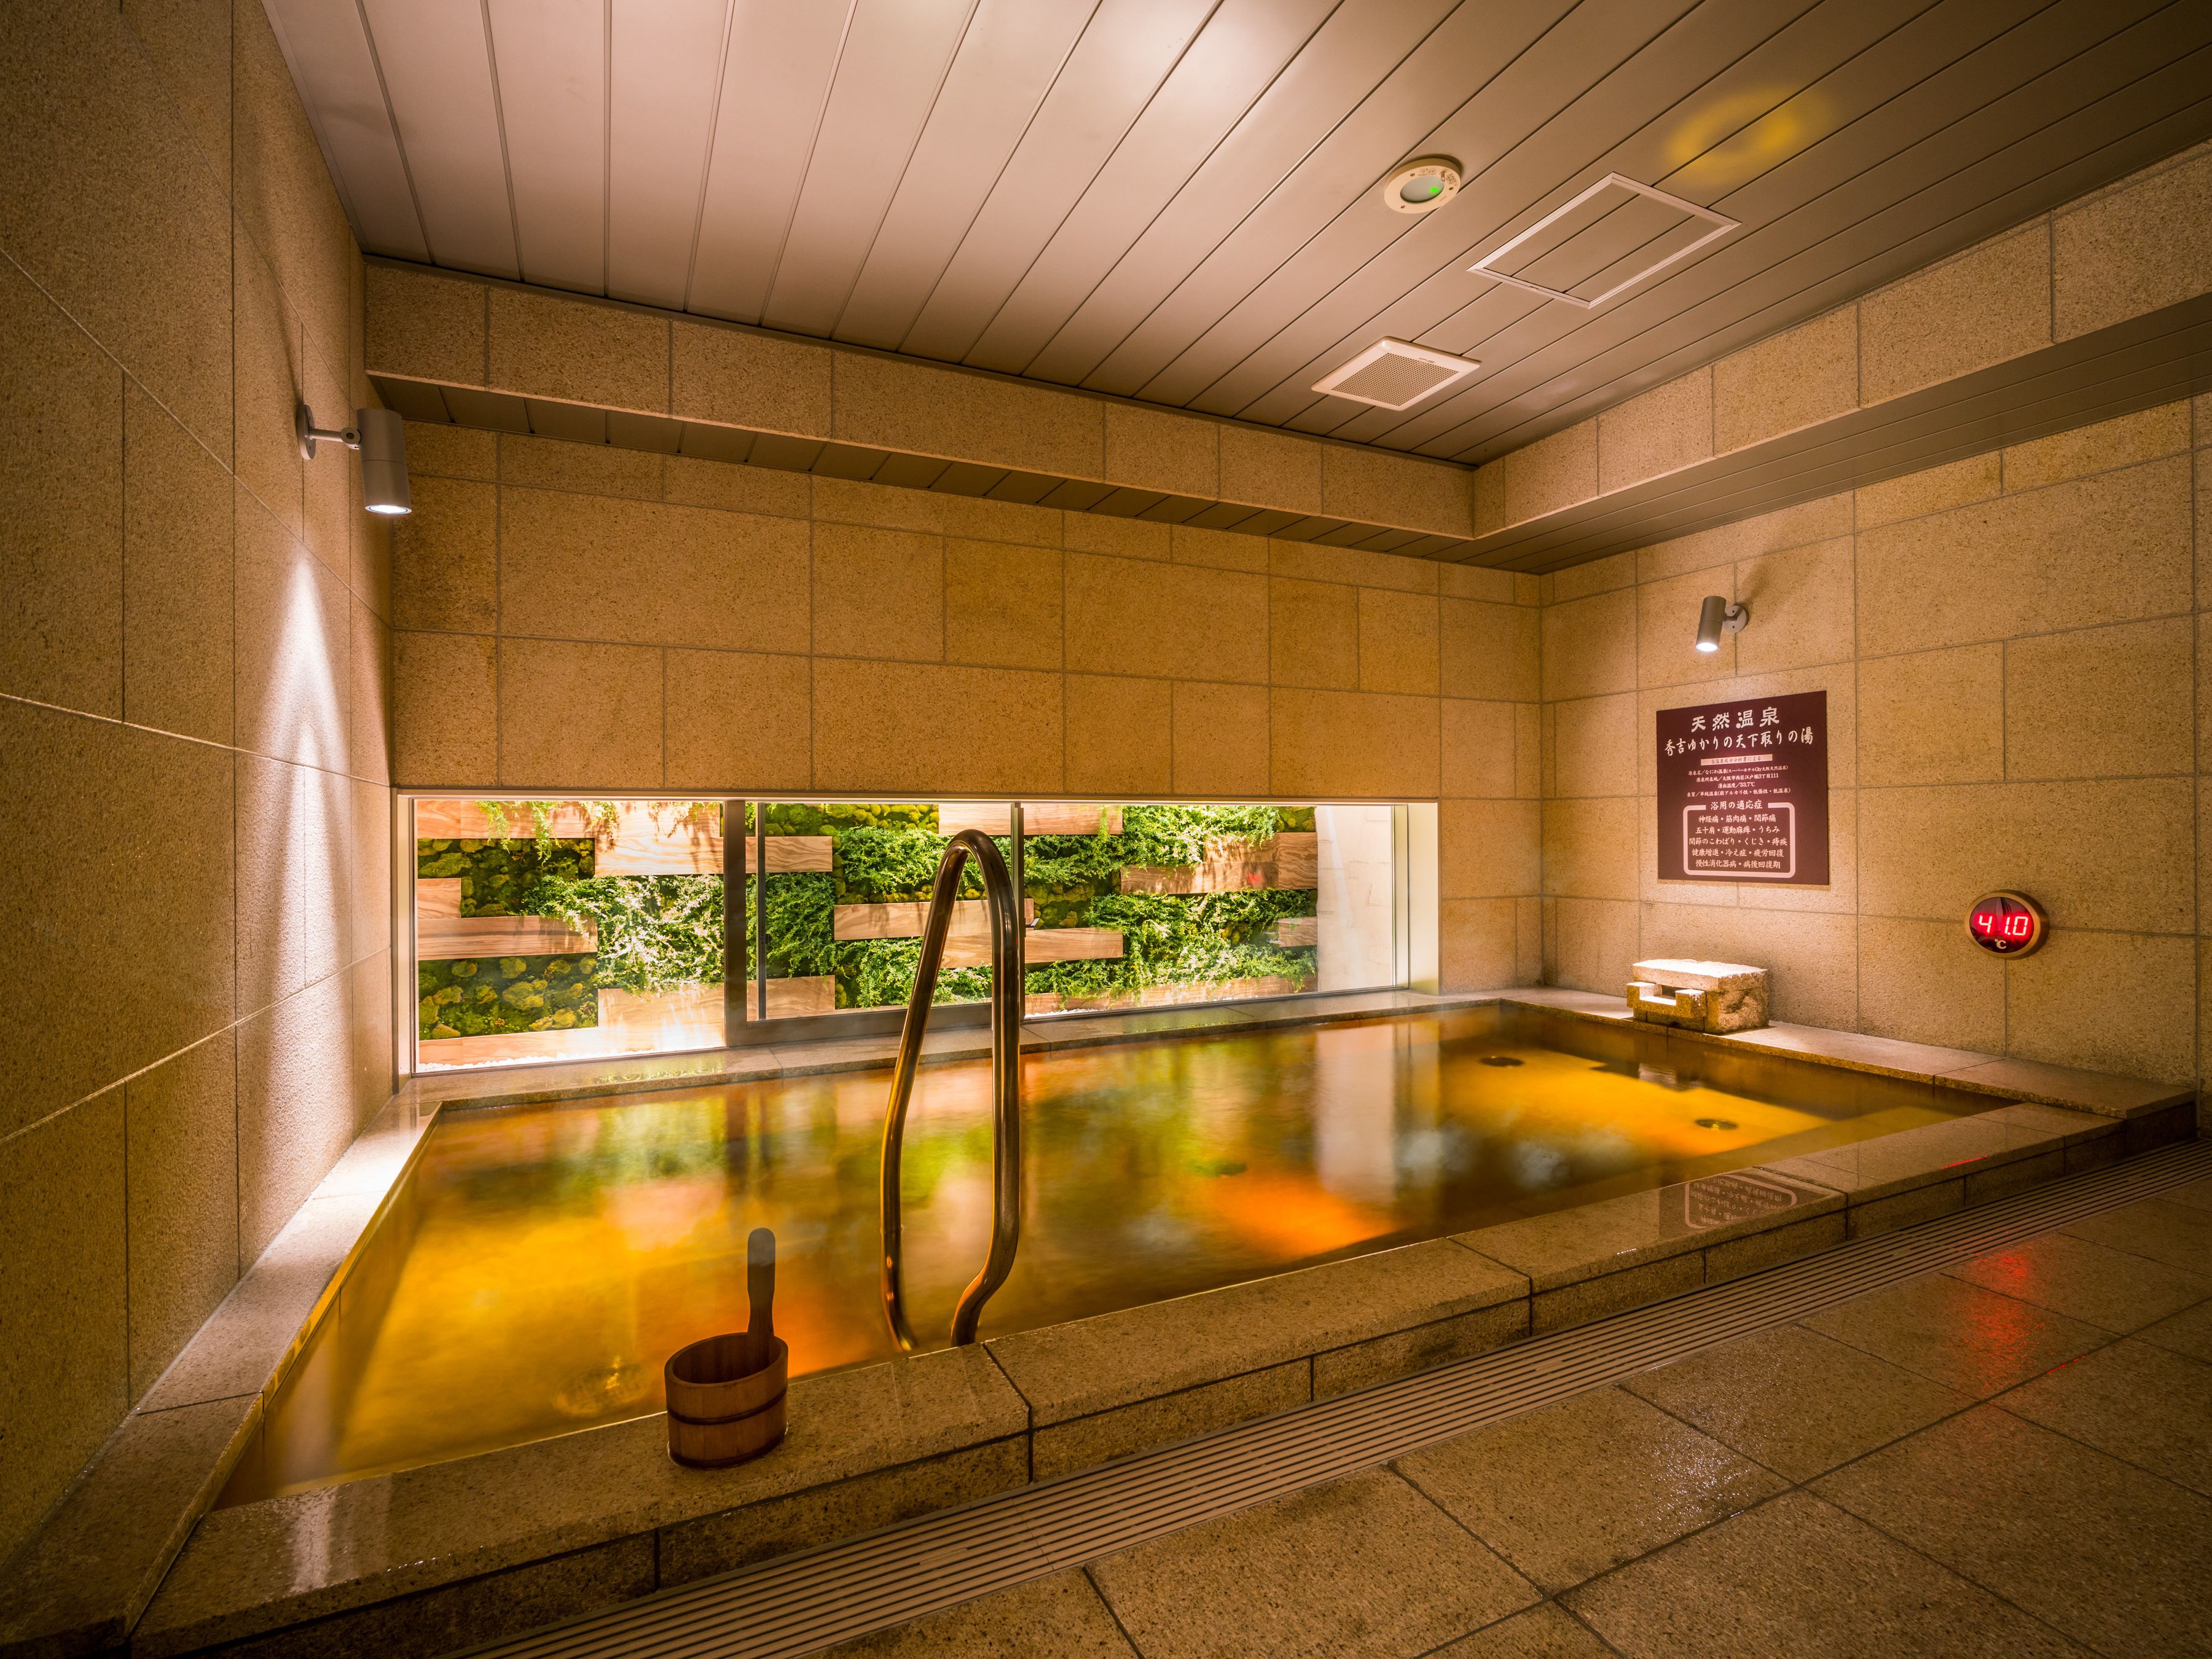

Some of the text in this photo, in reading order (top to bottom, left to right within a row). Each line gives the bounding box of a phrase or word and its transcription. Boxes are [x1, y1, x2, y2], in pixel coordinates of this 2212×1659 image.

[1691, 707, 1779, 732] 天然温泉
[1665, 726, 1813, 756] 秀吉ゆかりの天下取りの湯
[1711, 799, 1763, 810] 浴用の適応症
[1698, 814, 1776, 823] 神経痛・筋肉痛・関節痛
[1692, 848, 1784, 857] 健康増進・冷え症・疲労回復
[1979, 915, 2028, 935] 41.0
